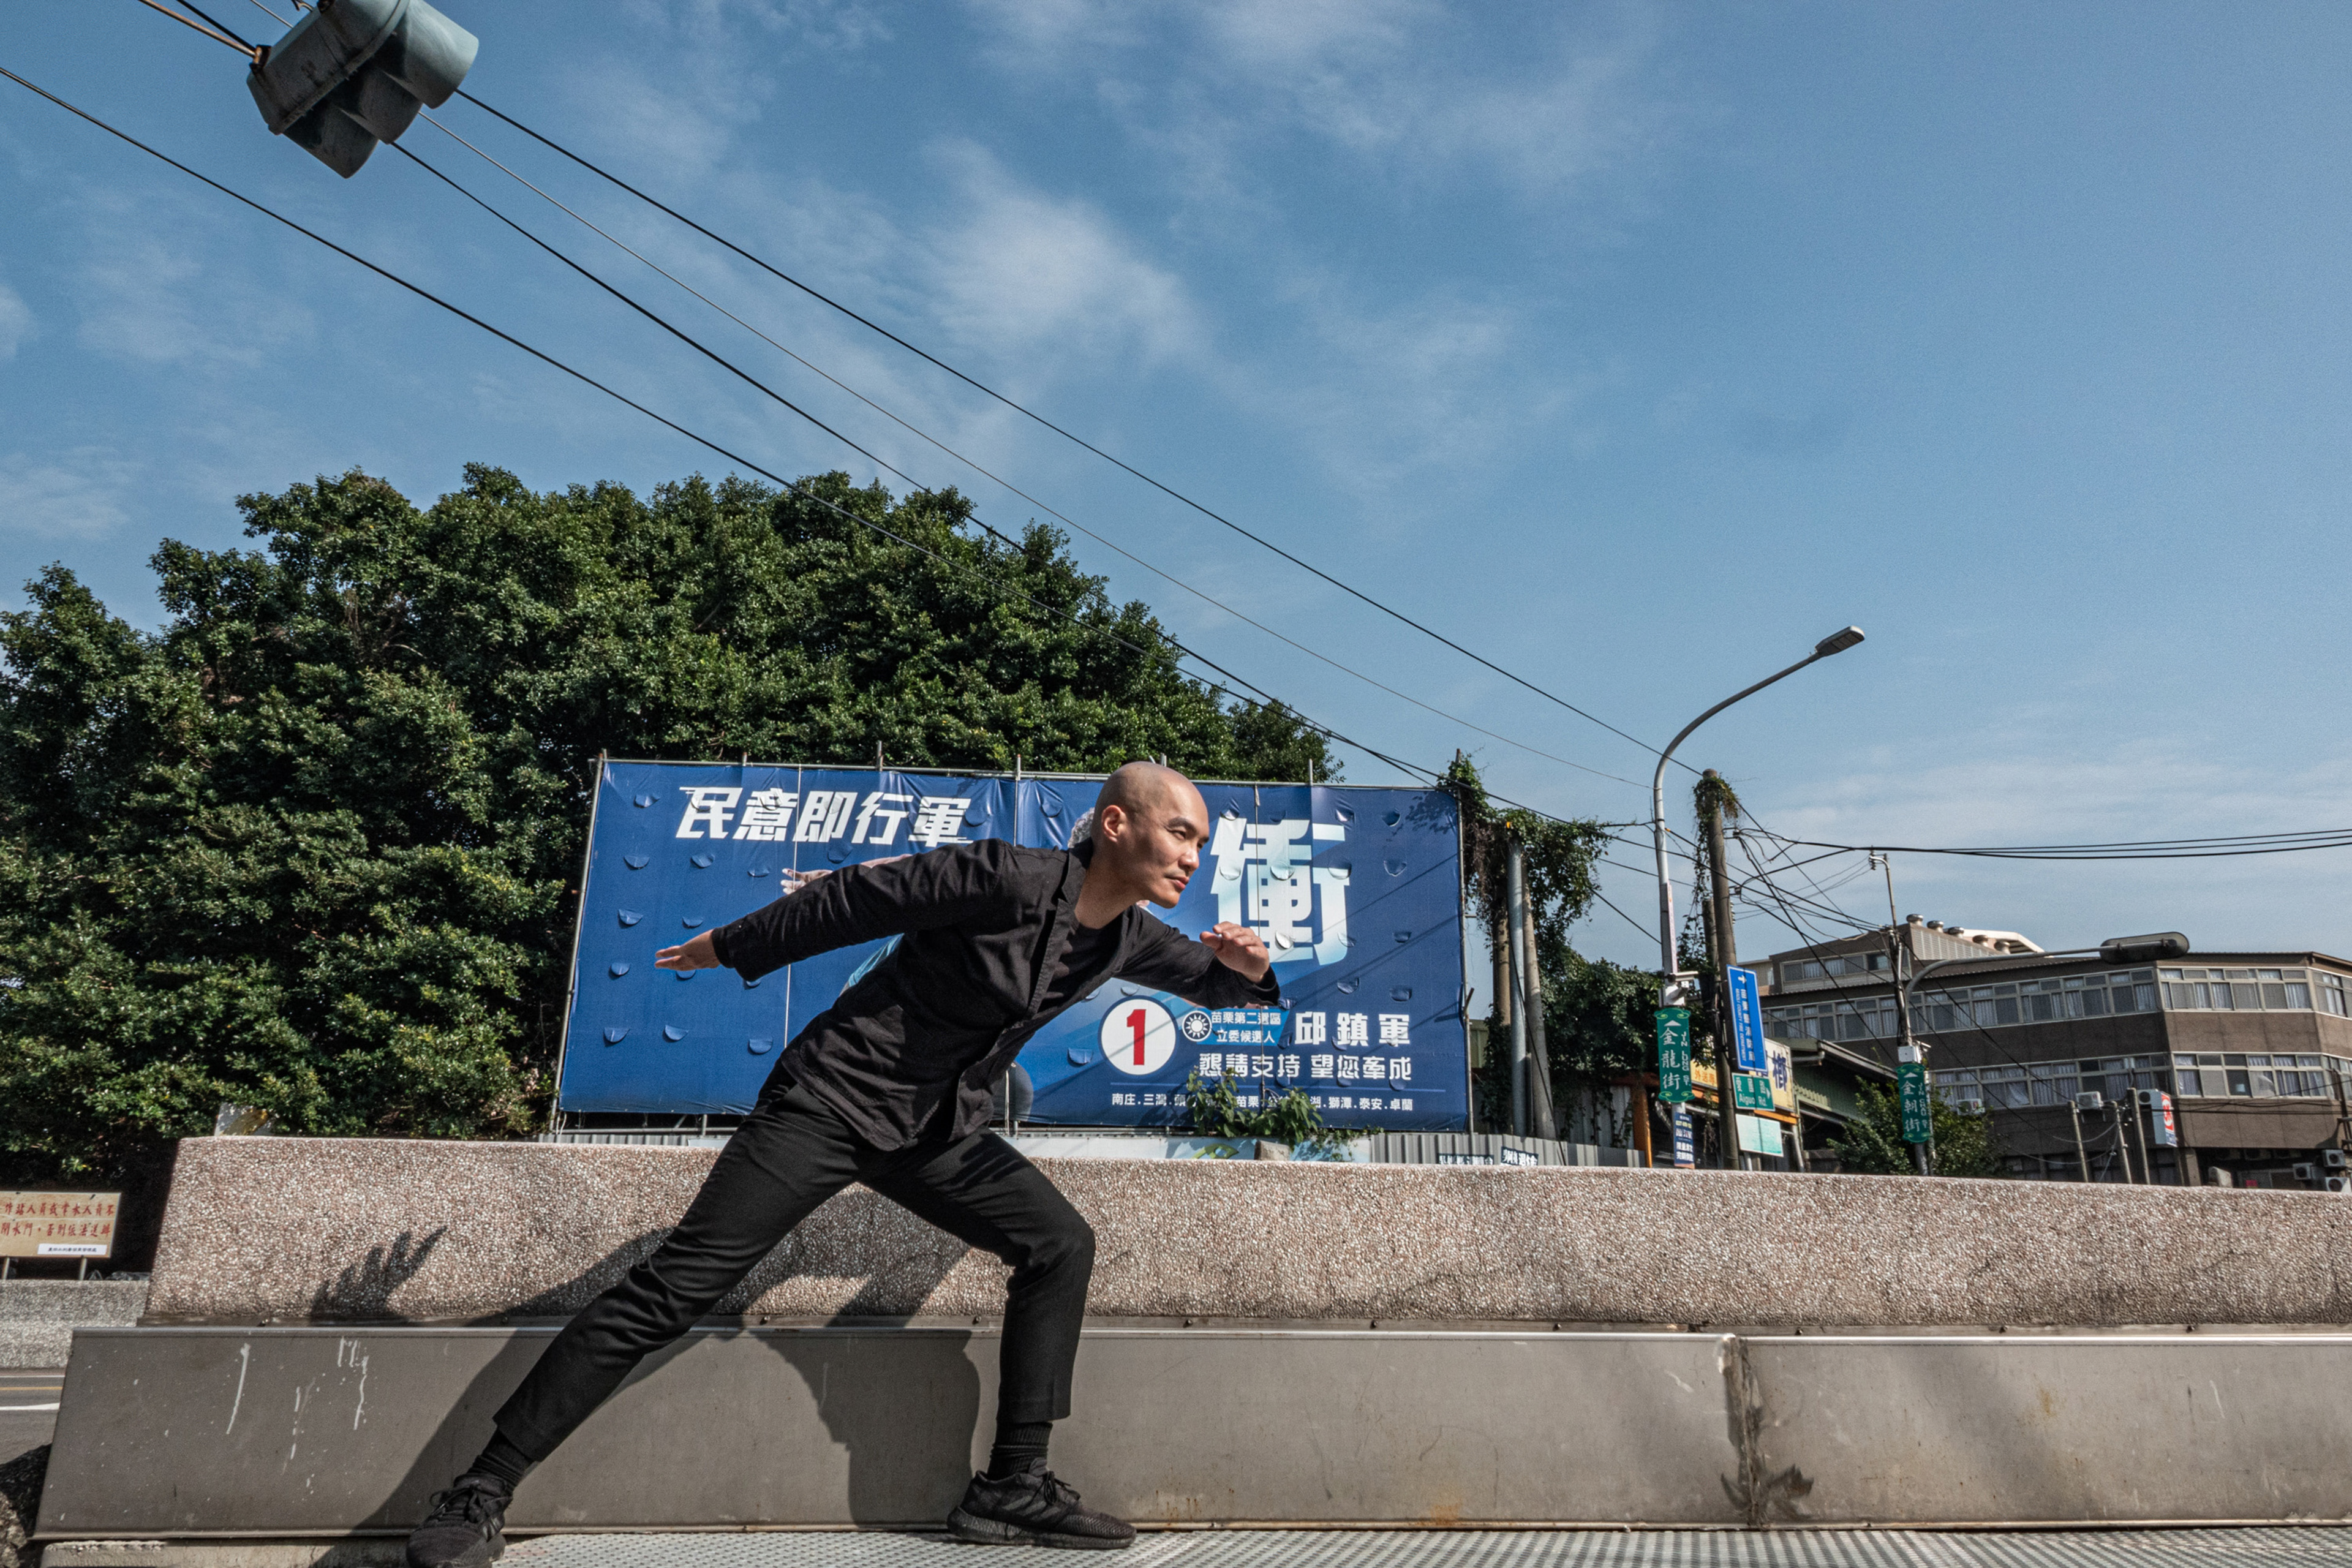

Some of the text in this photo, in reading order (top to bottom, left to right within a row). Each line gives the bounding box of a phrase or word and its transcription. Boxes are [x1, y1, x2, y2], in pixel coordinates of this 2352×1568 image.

[676, 786, 973, 847] 民意即行軍
[1210, 816, 1350, 965] 衝
[1126, 1009, 1147, 1066] 1
[1211, 1011, 1282, 1025] 苗栗第二選區
[1216, 1030, 1275, 1043] 立委候選人
[1295, 1011, 1410, 1047] 邱鎮軍
[1199, 1053, 1411, 1080] 懇請支持 望您牽成
[1659, 1027, 1681, 1091] 金龍街
[1739, 1093, 1756, 1106] Aiguo
[1901, 1080, 1920, 1132] 金朝街
